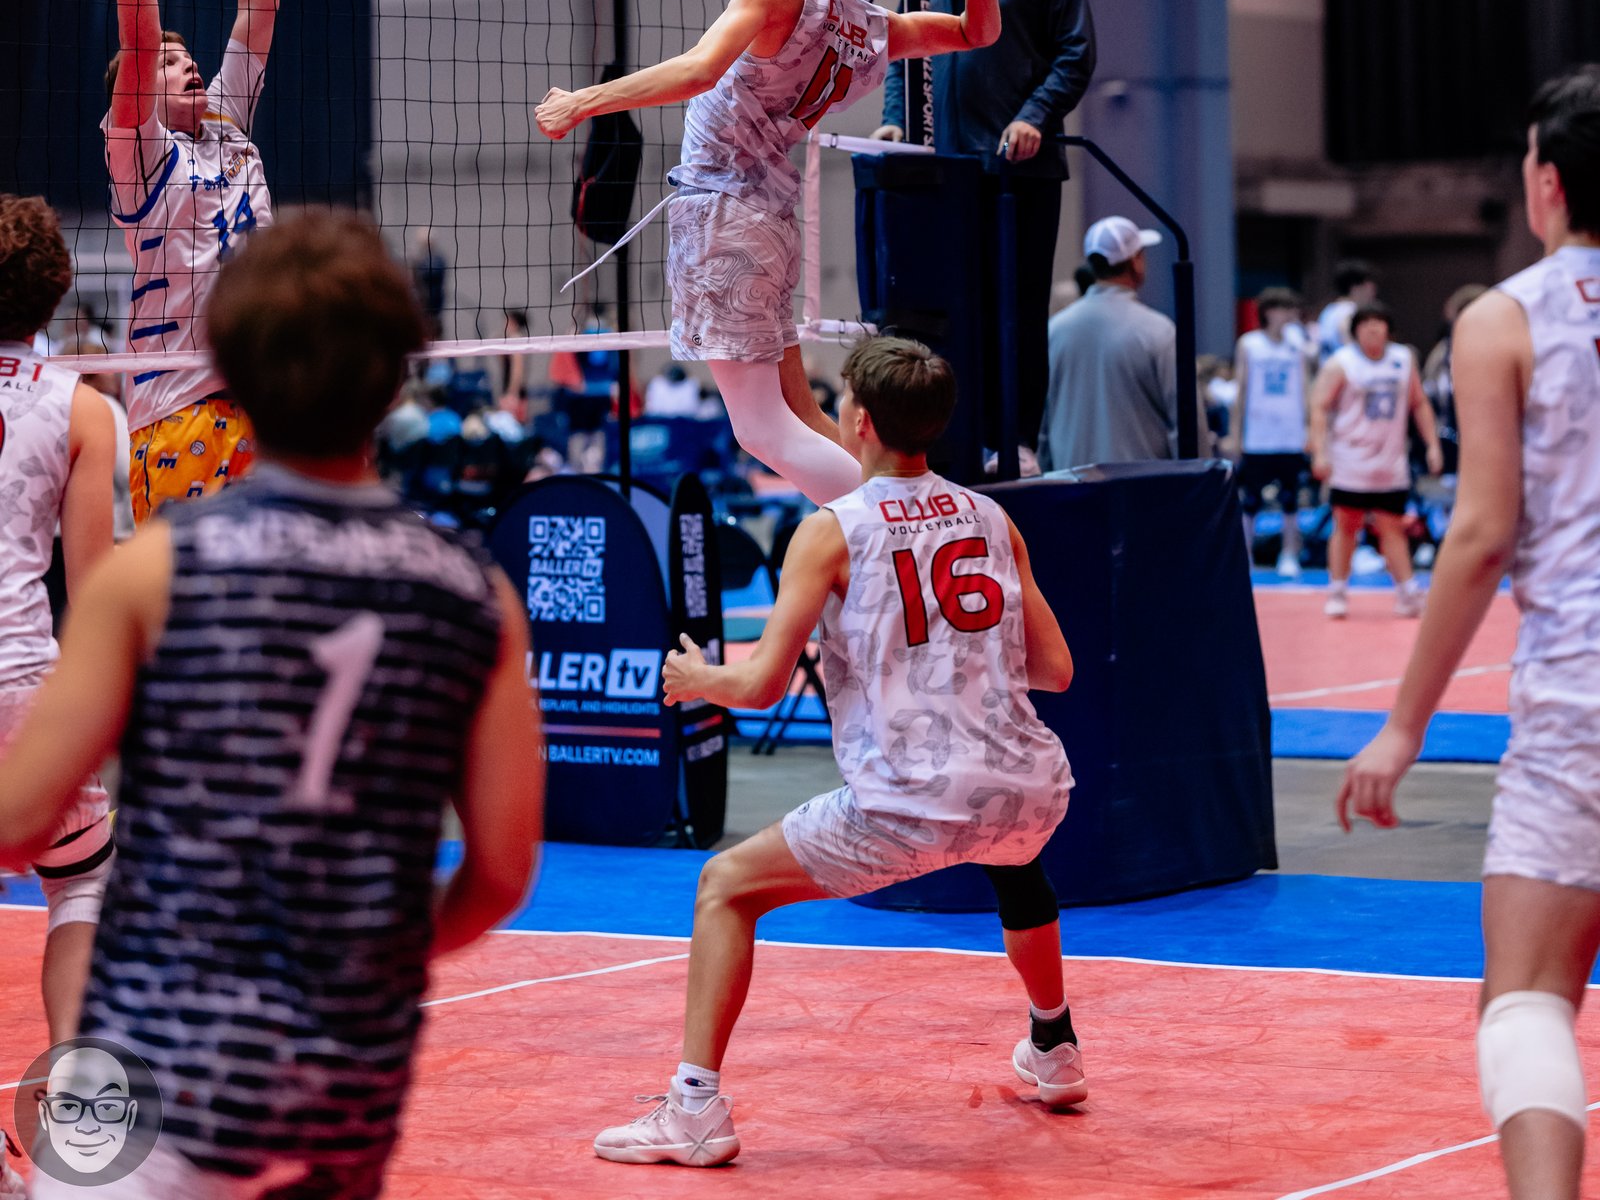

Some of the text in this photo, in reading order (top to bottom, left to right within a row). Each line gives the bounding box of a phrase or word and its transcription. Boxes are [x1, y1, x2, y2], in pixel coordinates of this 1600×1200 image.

[879, 491, 977, 523] CLUB 1
[888, 513, 981, 536] VOLLEYBALL
[892, 536, 1005, 648] 16
[525, 651, 607, 692] LLER
